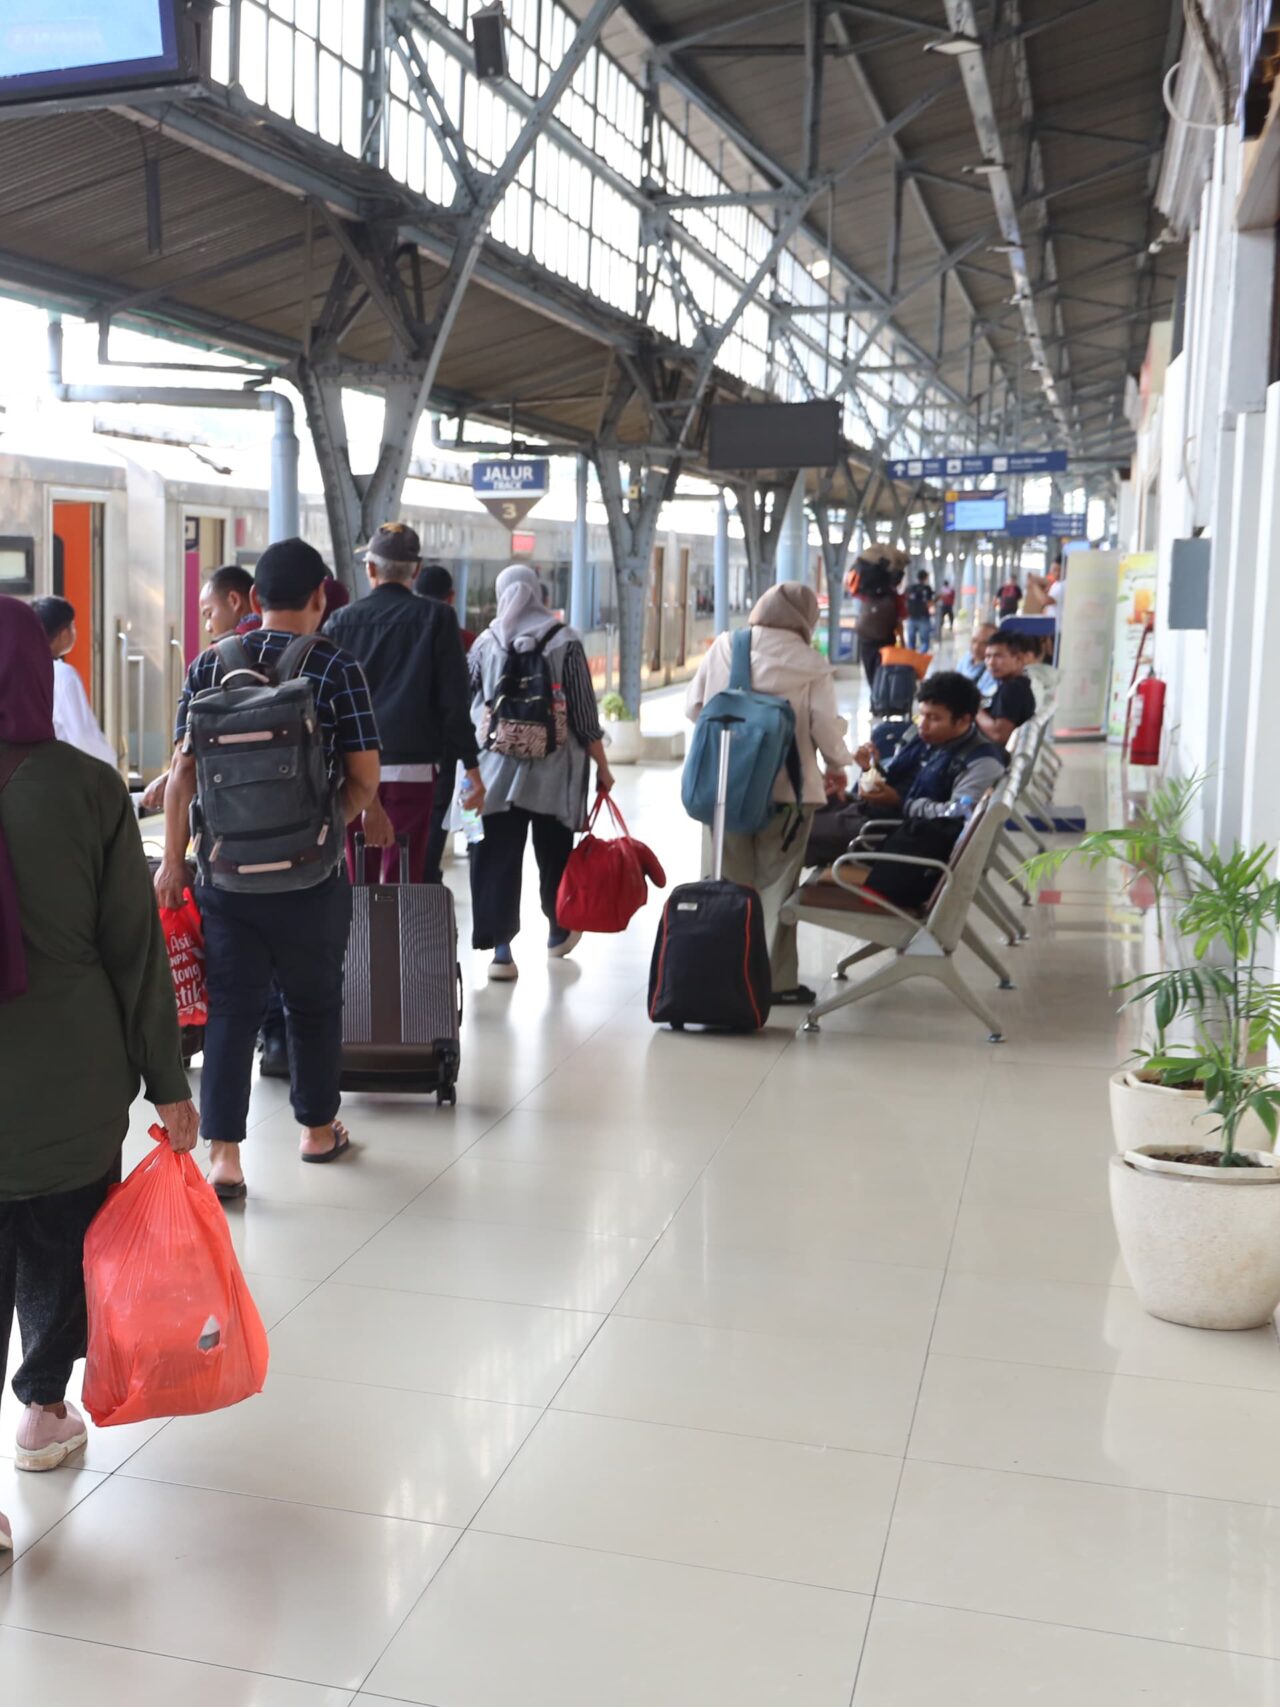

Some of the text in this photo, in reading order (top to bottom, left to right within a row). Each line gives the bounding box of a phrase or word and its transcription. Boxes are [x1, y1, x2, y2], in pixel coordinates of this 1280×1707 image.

[482, 465, 534, 481] JALUR
[493, 481, 522, 490] TRACK
[502, 502, 517, 519] 3
